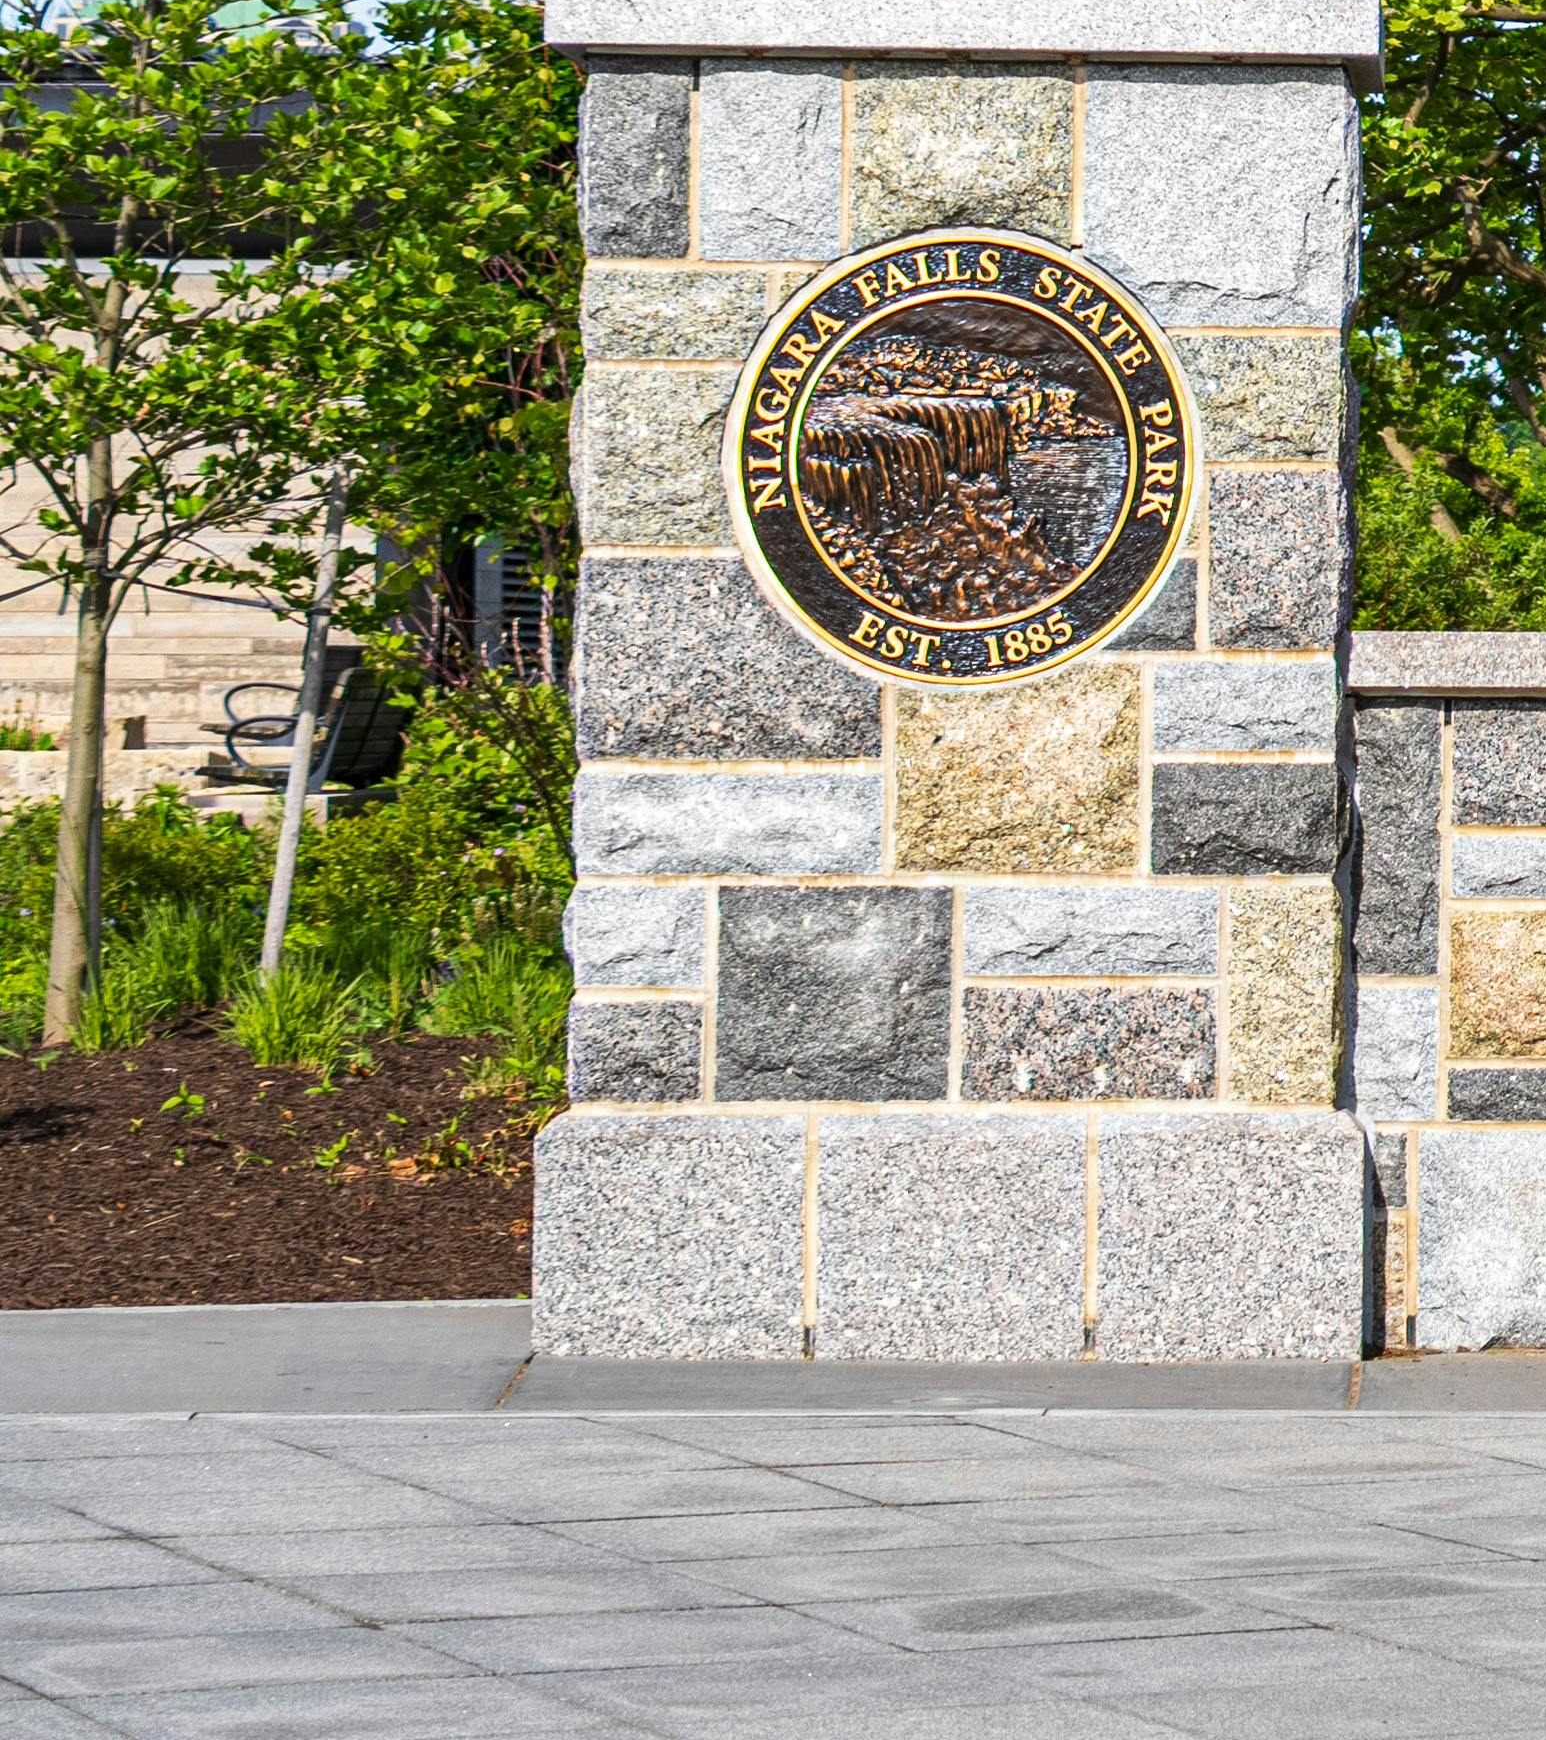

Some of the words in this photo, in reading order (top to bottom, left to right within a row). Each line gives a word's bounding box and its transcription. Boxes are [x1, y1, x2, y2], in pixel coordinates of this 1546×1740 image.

[748, 311, 845, 515] NIAGARA
[850, 249, 1002, 308] FALLS
[1034, 266, 1152, 376] STATE
[1137, 398, 1178, 526] PARK
[848, 611, 952, 669] EST.
[984, 611, 1073, 666] 1885
